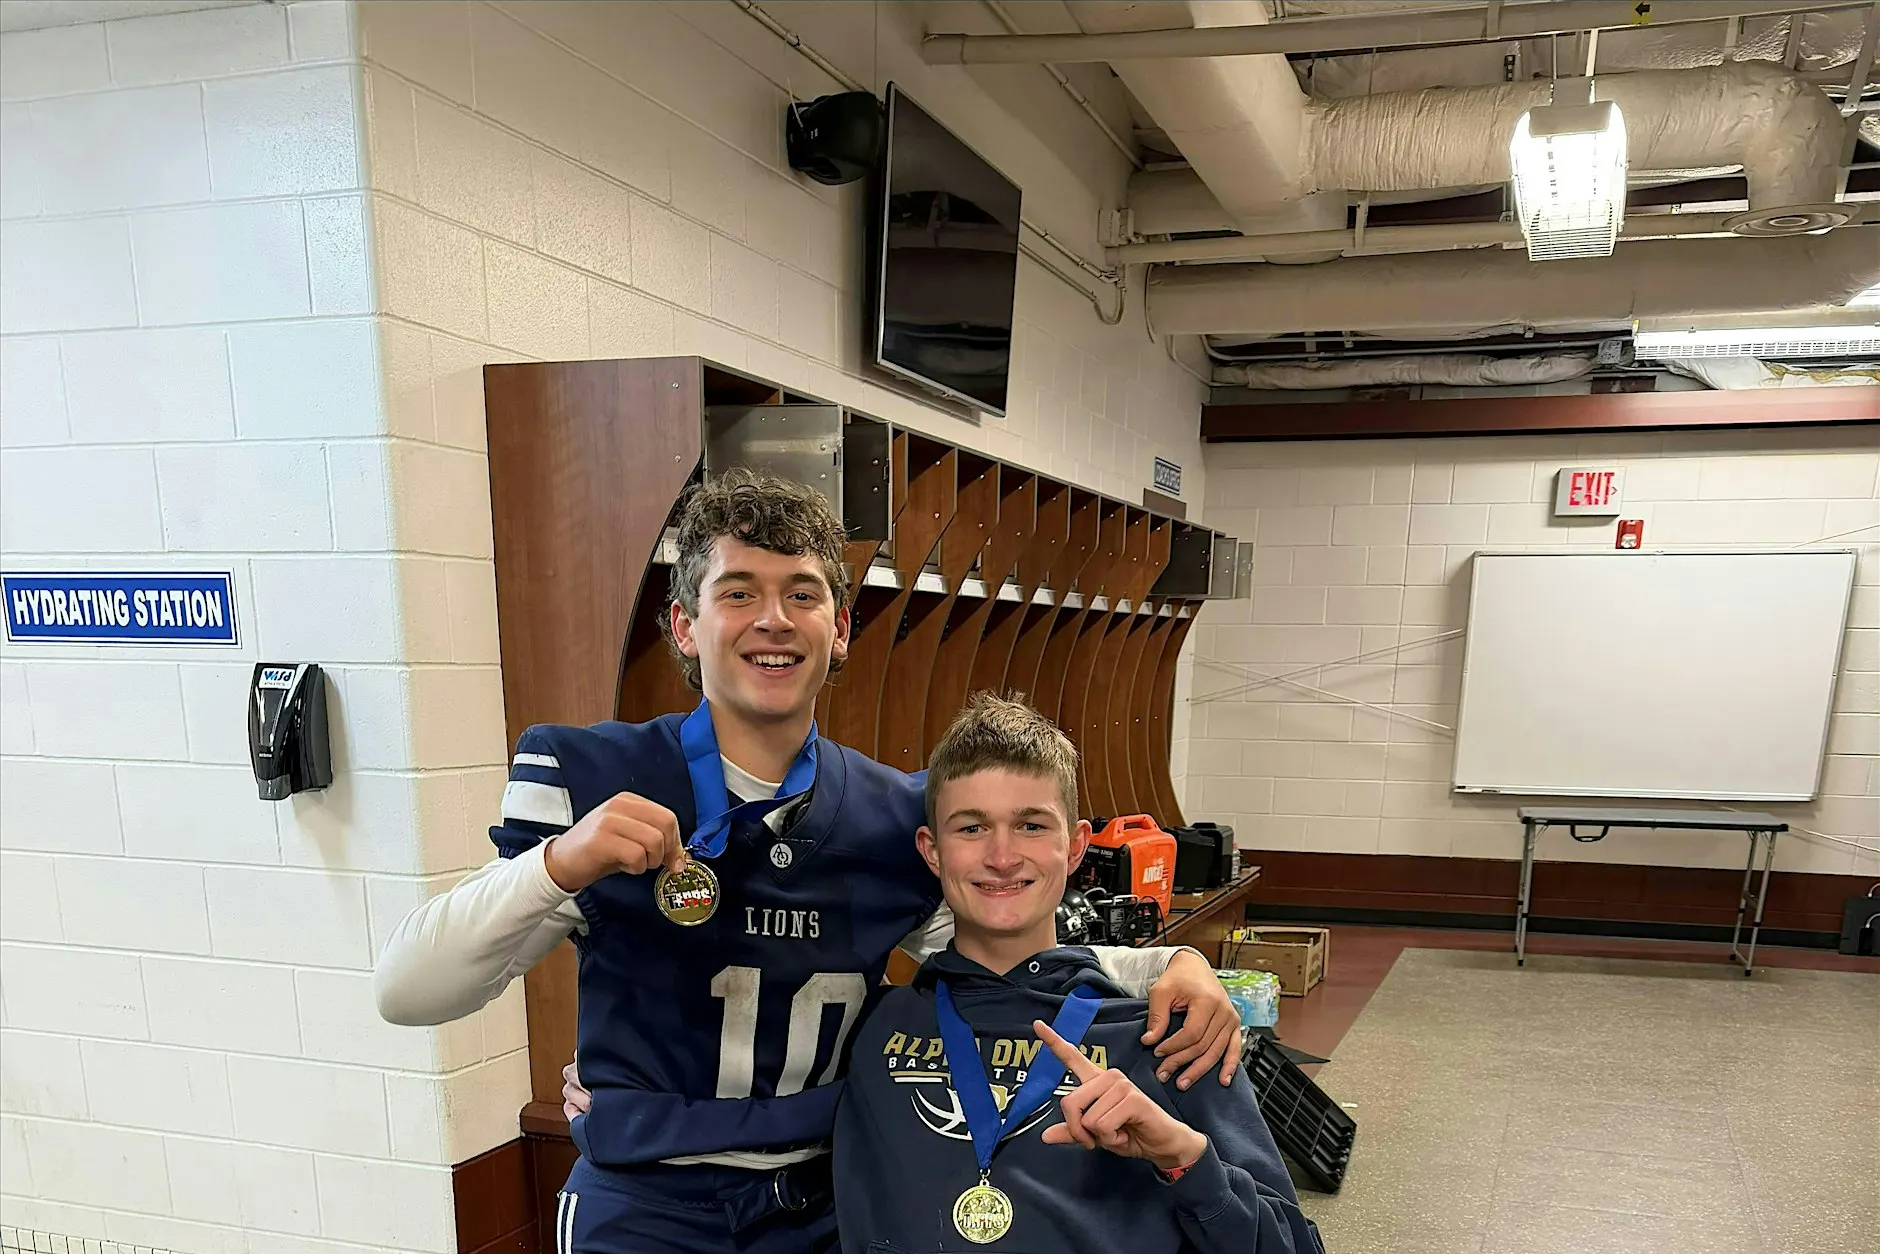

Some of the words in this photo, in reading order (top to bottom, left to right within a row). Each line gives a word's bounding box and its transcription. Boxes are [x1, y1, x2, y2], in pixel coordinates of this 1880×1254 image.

[1569, 472, 1615, 506] EXIT
[12, 588, 130, 627] HYDRATING
[134, 588, 224, 628] STATION
[745, 906, 820, 939] LIONS
[711, 965, 867, 1100] 10
[883, 1031, 981, 1067] ALP
[991, 1039, 1108, 1071] OMA
